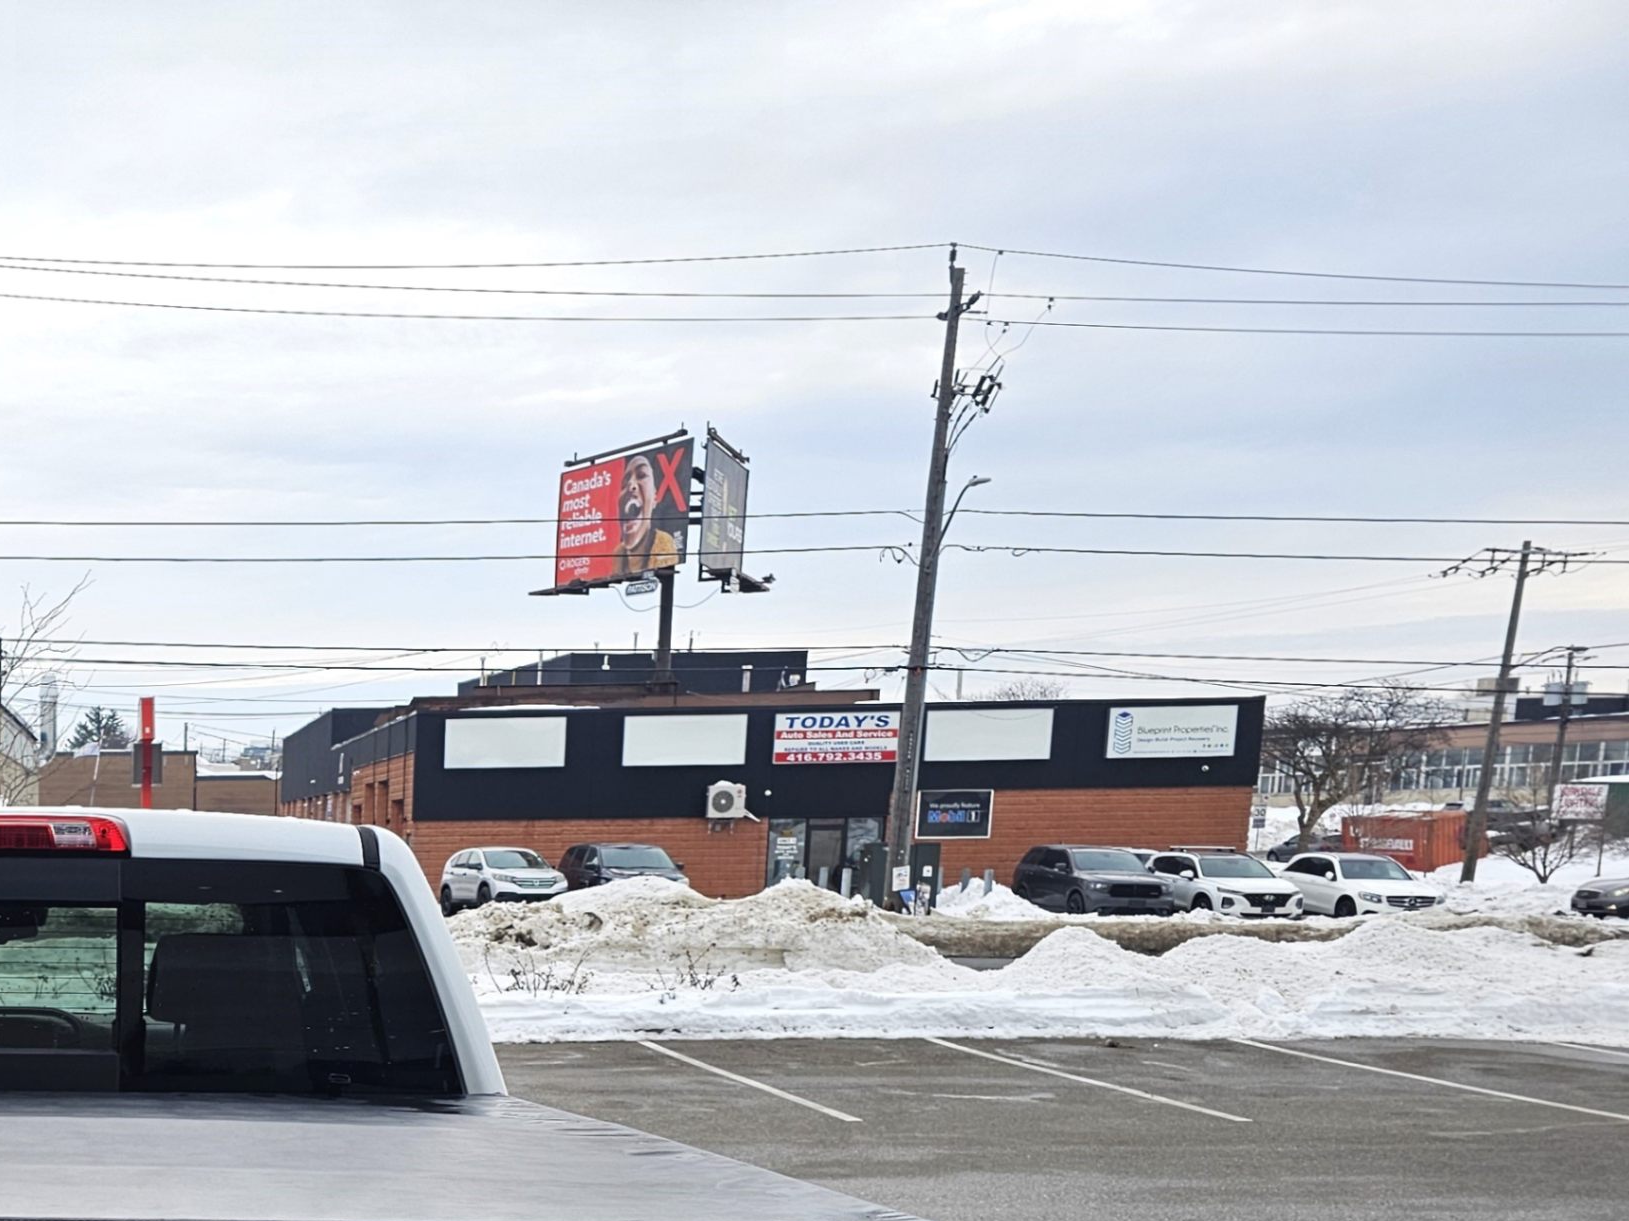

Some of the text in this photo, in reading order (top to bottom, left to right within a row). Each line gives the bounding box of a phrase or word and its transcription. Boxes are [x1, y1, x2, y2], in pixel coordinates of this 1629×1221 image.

[563, 470, 611, 495] Canada's
[656, 447, 687, 512] X
[562, 493, 591, 513] most
[561, 507, 603, 530] reliable
[560, 528, 606, 549] internet.
[785, 715, 890, 729] TODAY'S
[806, 731, 833, 739] Sales
[856, 730, 893, 738] Service
[1137, 726, 1172, 735] Blueprint
[786, 752, 882, 762] 416.792.3435
[927, 810, 966, 823] Mobil
[1254, 808, 1267, 817] 30
